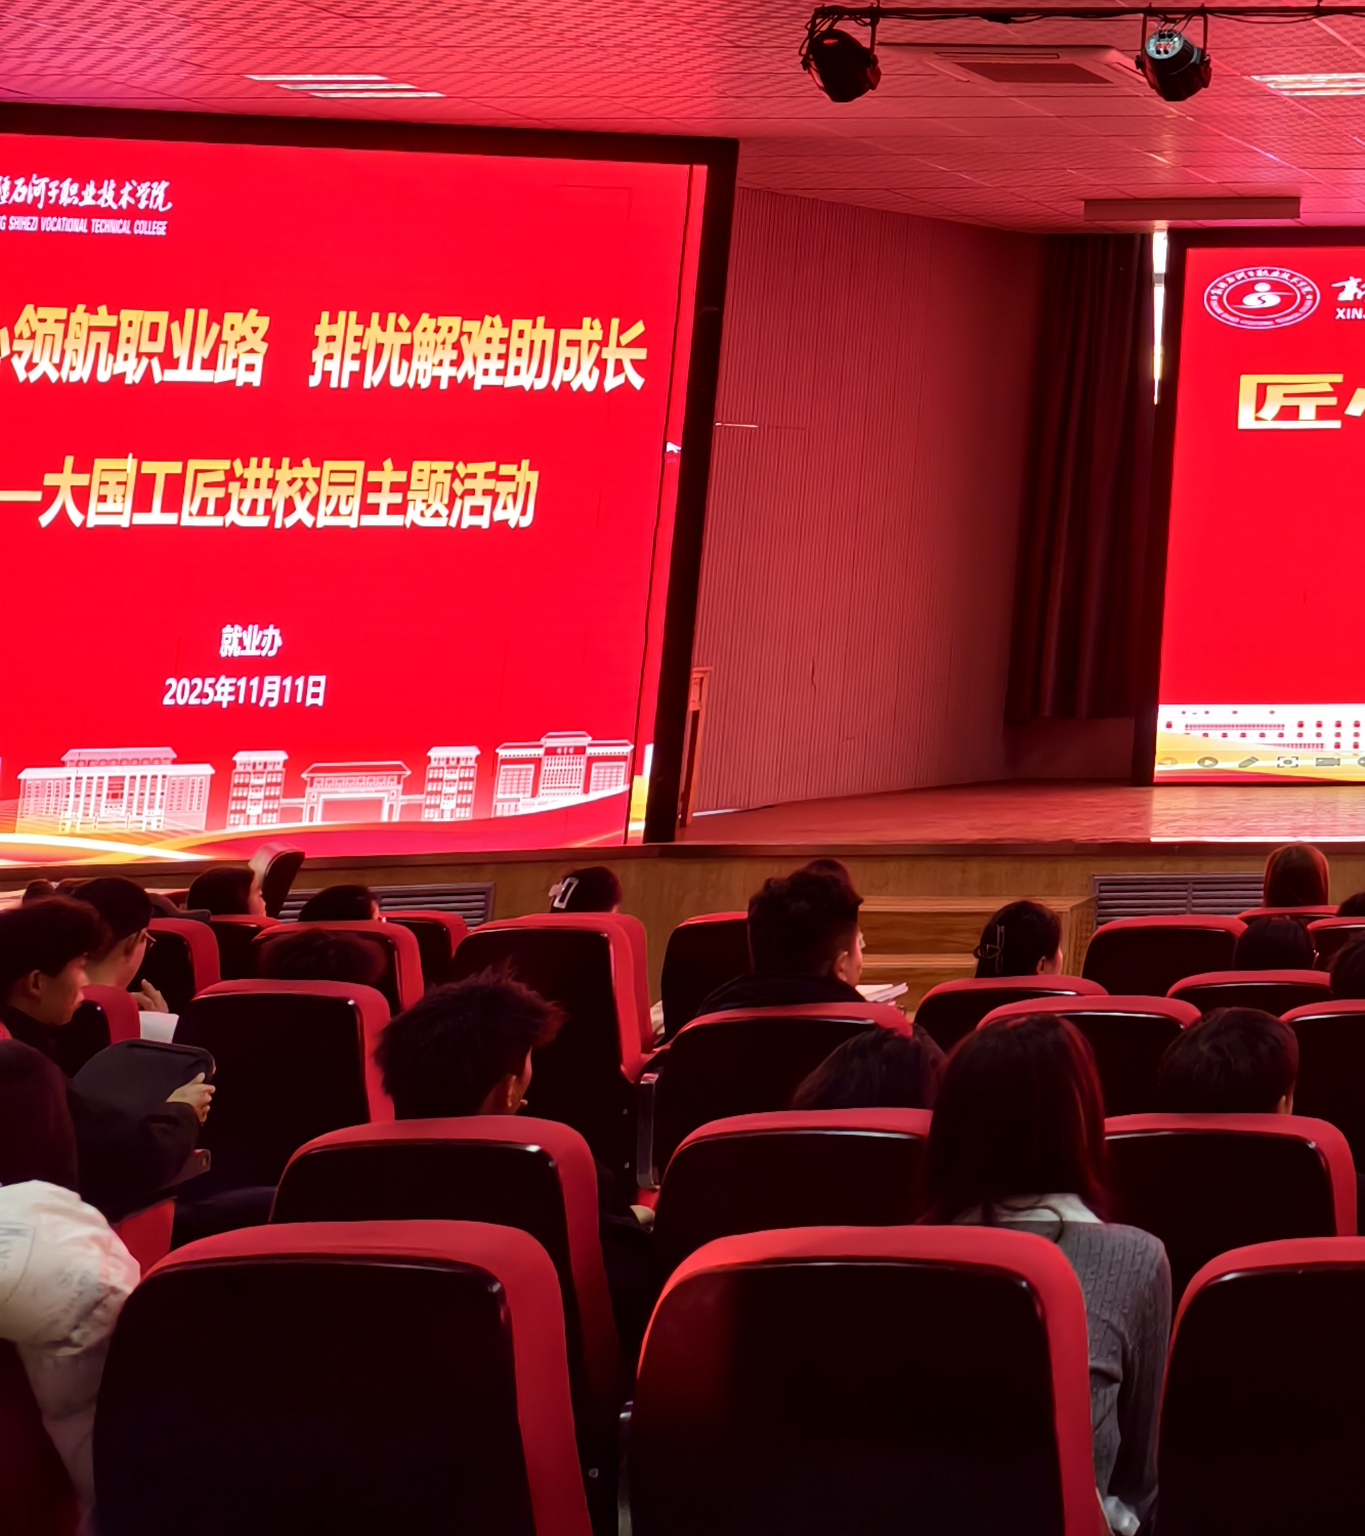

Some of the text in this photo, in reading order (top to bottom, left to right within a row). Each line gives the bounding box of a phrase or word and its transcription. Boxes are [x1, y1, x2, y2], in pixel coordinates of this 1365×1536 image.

[41, 217, 88, 233] VOCATIONAL
[92, 219, 131, 234] TECHNICAL
[134, 220, 167, 235] COLLEGE
[0, 304, 647, 393] 领航职业路 排忧解难助成长
[220, 624, 282, 657] 就业办
[163, 675, 326, 708] 2025年11月11日
